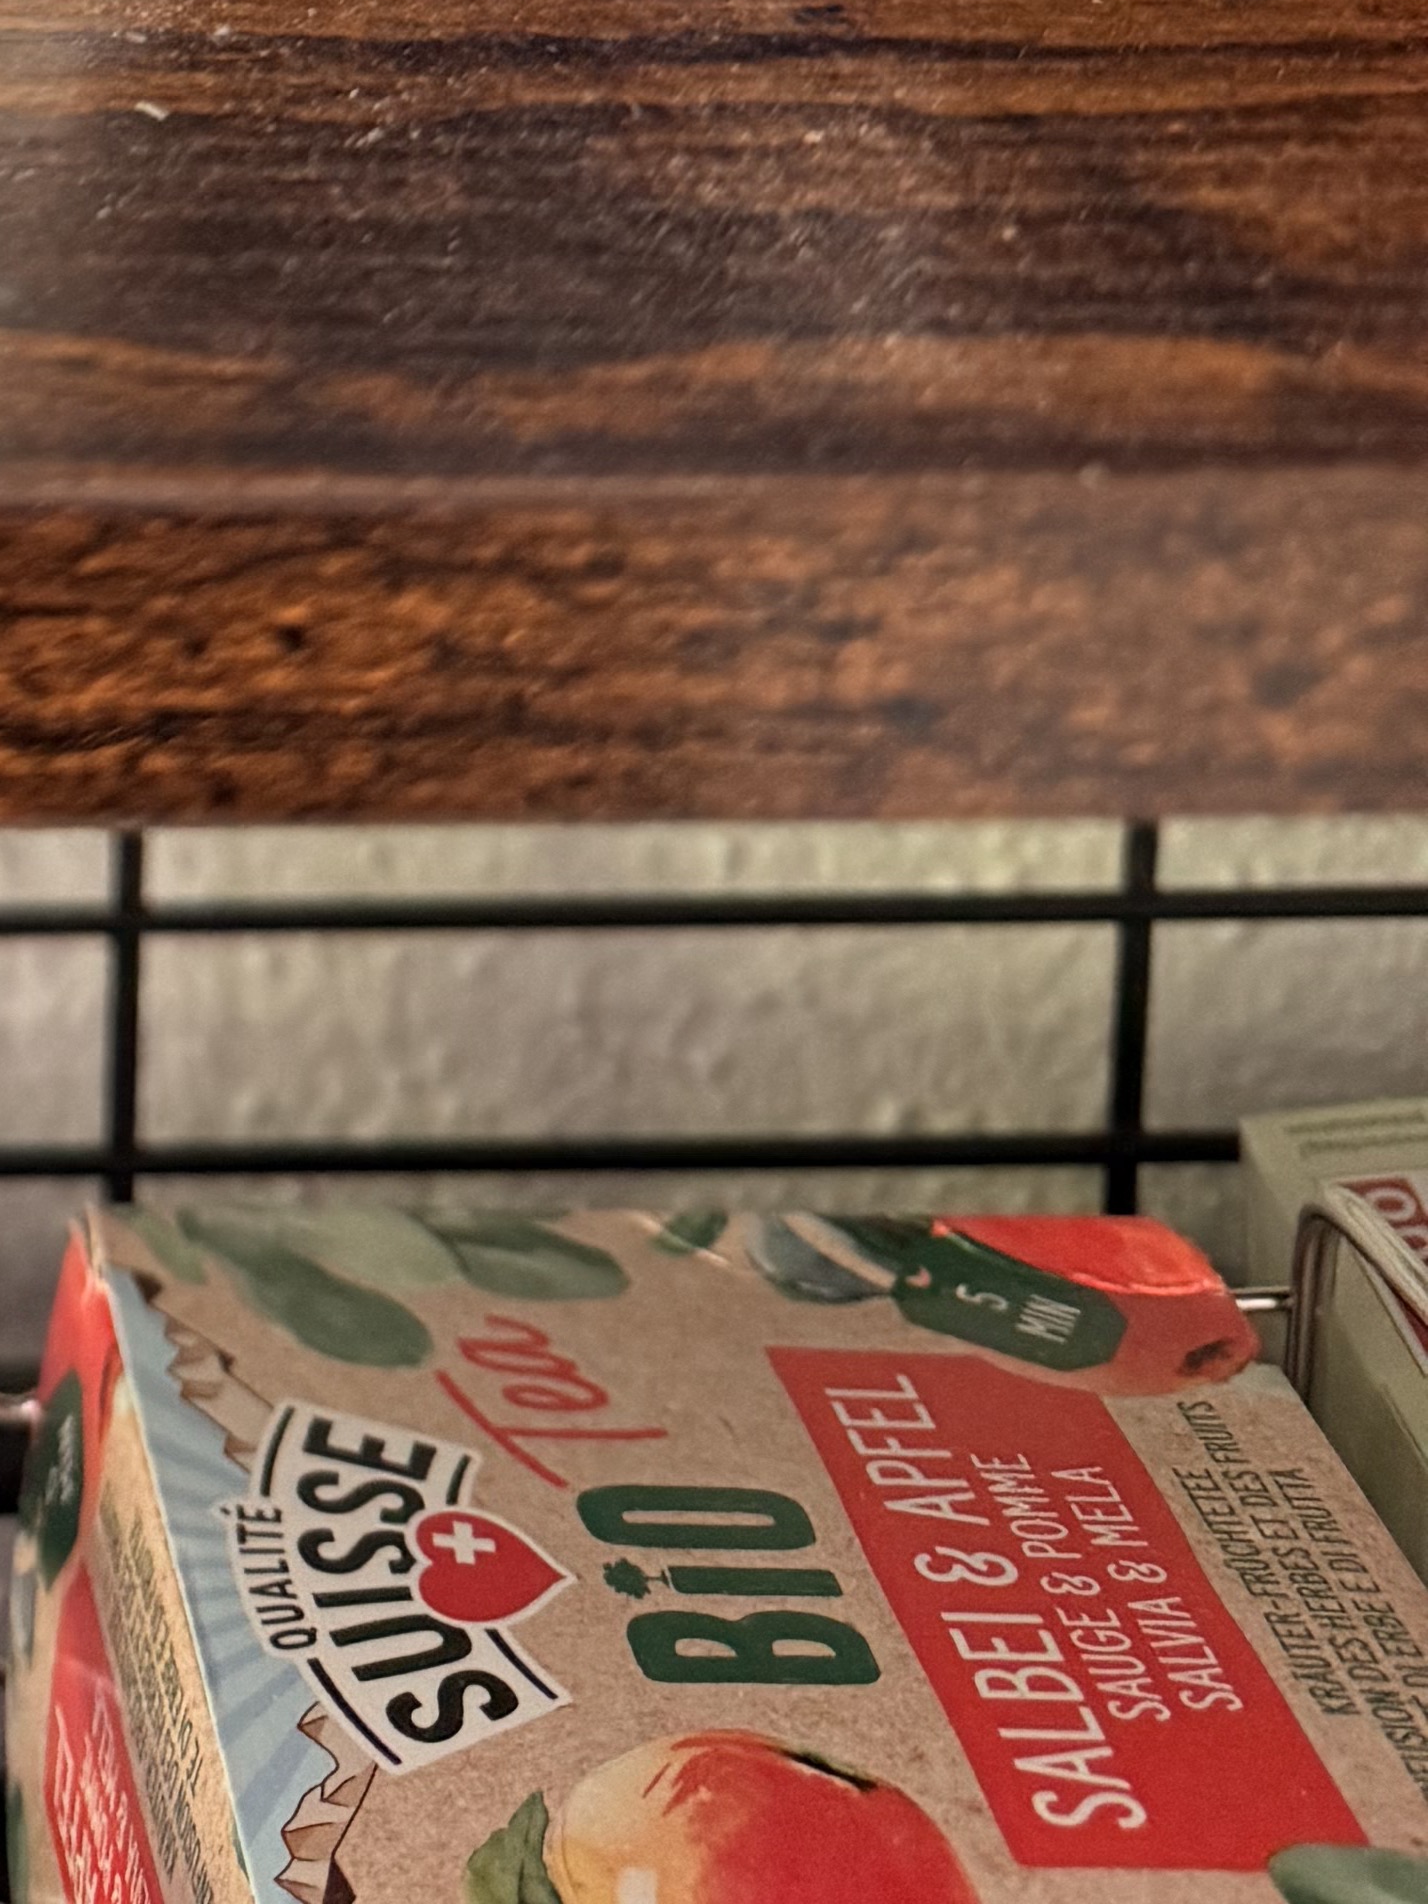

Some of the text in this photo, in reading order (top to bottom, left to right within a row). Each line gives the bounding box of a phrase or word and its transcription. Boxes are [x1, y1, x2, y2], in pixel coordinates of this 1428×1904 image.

[1013, 1293, 1082, 1344] MIN
[434, 1311, 670, 1491] Tea
[1176, 1399, 1252, 1464] FRUITS
[824, 1373, 991, 1527] APFEL
[1220, 1468, 1281, 1509] DES
[969, 1452, 1083, 1560] POMME
[1051, 1465, 1150, 1548] MELA
[1250, 1513, 1302, 1542] ET
[1268, 1466, 1353, 1546] FRUTTA
[218, 1503, 318, 1651] QUALITÉ
[295, 1415, 520, 1744] SUISSE
[1273, 1545, 1358, 1630] HERBES
[1320, 1549, 1370, 1575] DI
[1338, 1576, 1383, 1594] E
[1056, 1606, 1173, 1722] SAUGE
[1127, 1595, 1245, 1712] SALVIA
[1327, 1635, 1393, 1683] DES
[1350, 1599, 1425, 1658] ERBE
[940, 1611, 1148, 1830] SALBEI
